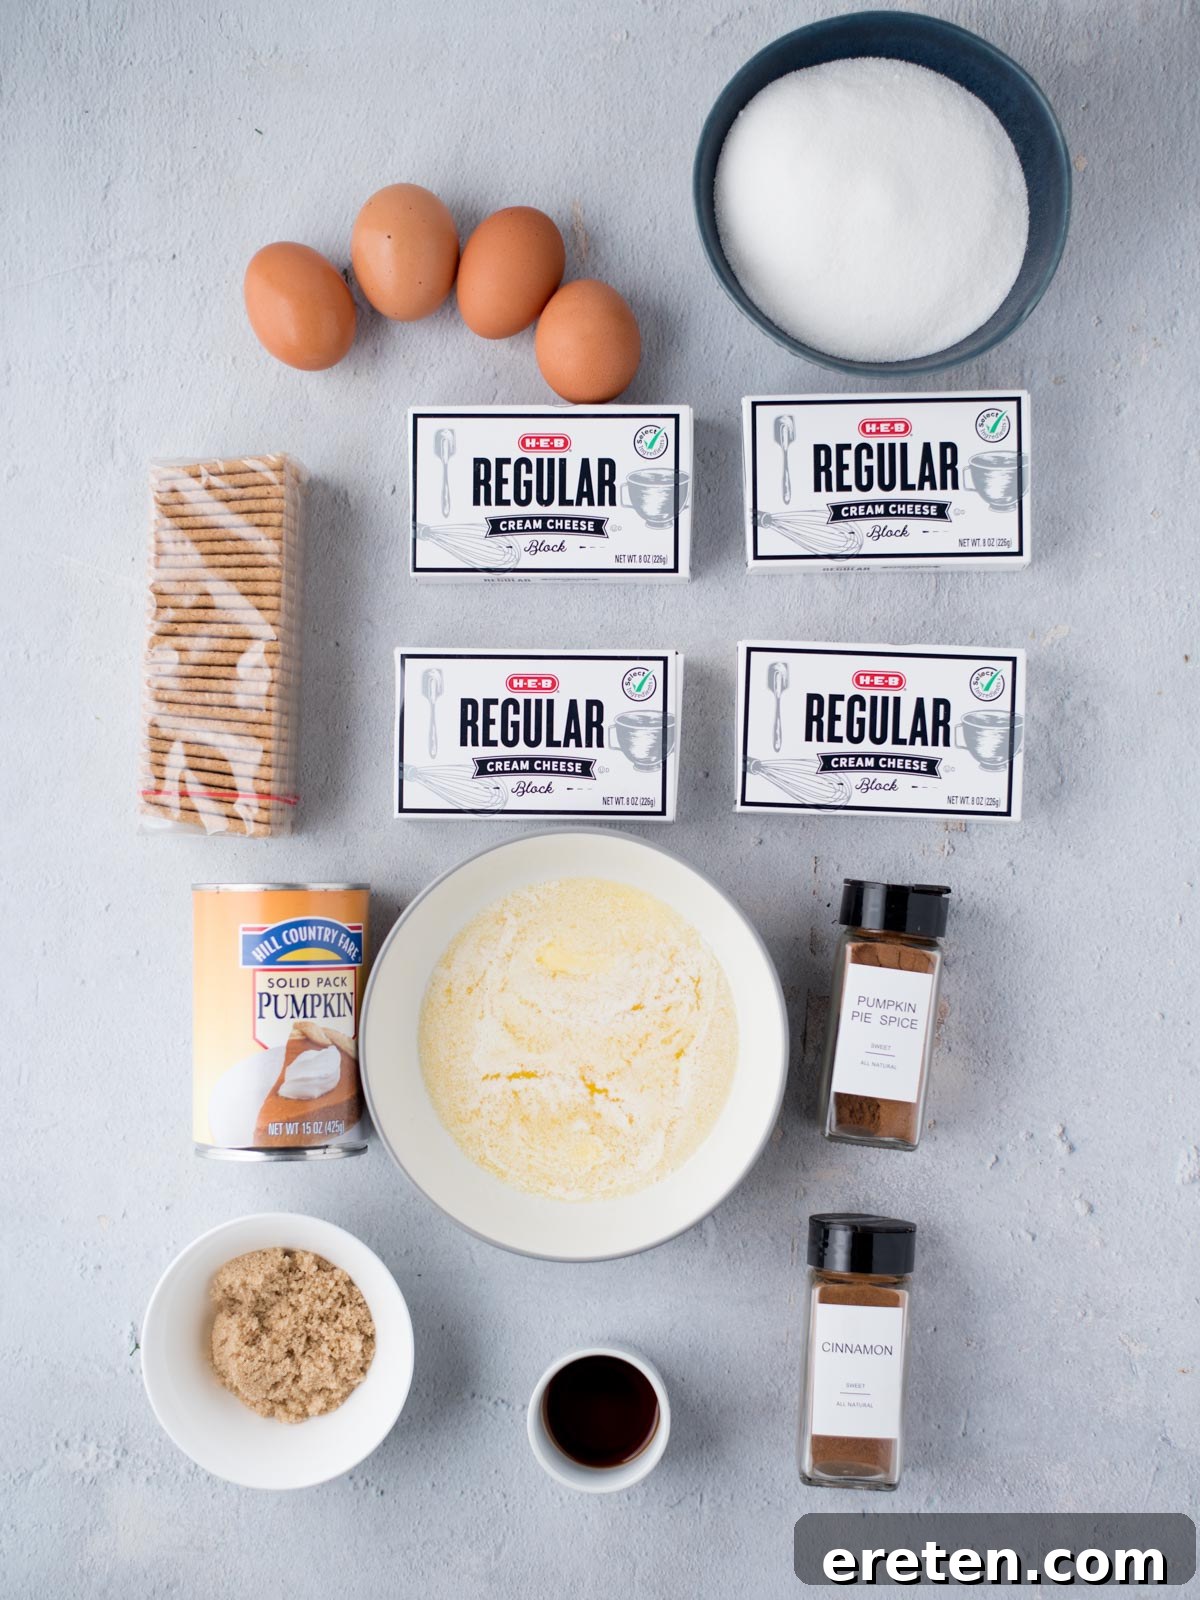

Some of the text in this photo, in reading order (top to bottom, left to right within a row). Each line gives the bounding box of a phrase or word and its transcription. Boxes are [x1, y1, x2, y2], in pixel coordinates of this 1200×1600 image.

[978, 412, 1000, 428] Select
[636, 428, 657, 445] Select
[813, 441, 960, 493] REGULAR
[472, 457, 617, 507] REGULAR
[841, 504, 938, 517] CREAM CHEESE
[500, 519, 595, 532] CREAM CHEESE
[866, 524, 910, 541] Block
[523, 539, 567, 556] Block
[958, 538, 970, 548] NET
[982, 538, 987, 547] 8
[987, 538, 995, 547] OZ
[996, 537, 1013, 549] (226g)
[614, 554, 626, 564] NET
[638, 554, 643, 564] 8
[643, 554, 651, 564] OZ
[652, 554, 668, 566] (226g)
[624, 671, 646, 686] Select
[972, 671, 994, 686] Select
[460, 697, 605, 748] REGULAR
[804, 692, 951, 747] REGULAR
[486, 760, 583, 773] CREAM CHEESE
[831, 757, 928, 772] CREAM CHEESE
[511, 780, 555, 797] Block
[854, 777, 899, 793] Block
[602, 796, 613, 806] NET
[626, 796, 630, 806] 8
[631, 796, 639, 806] OZ
[640, 796, 656, 808] (226g)
[946, 795, 959, 805] NET
[971, 796, 975, 805] 8
[976, 796, 984, 806] OZ
[985, 797, 1001, 809] (226g)
[251, 925, 359, 963] HILL COUNTRY FARE
[267, 976, 348, 989] SOLID PACK
[257, 991, 354, 1019] PUMPKIN
[857, 995, 917, 1013] PUMPKIN
[851, 1011, 919, 1030] PIE SPICE
[870, 1042, 892, 1051] SWEET
[871, 1062, 897, 1070] NATURAL
[268, 1120, 345, 1136] NET WT 15 OZ (425g)
[821, 1341, 893, 1356] CINNAMON
